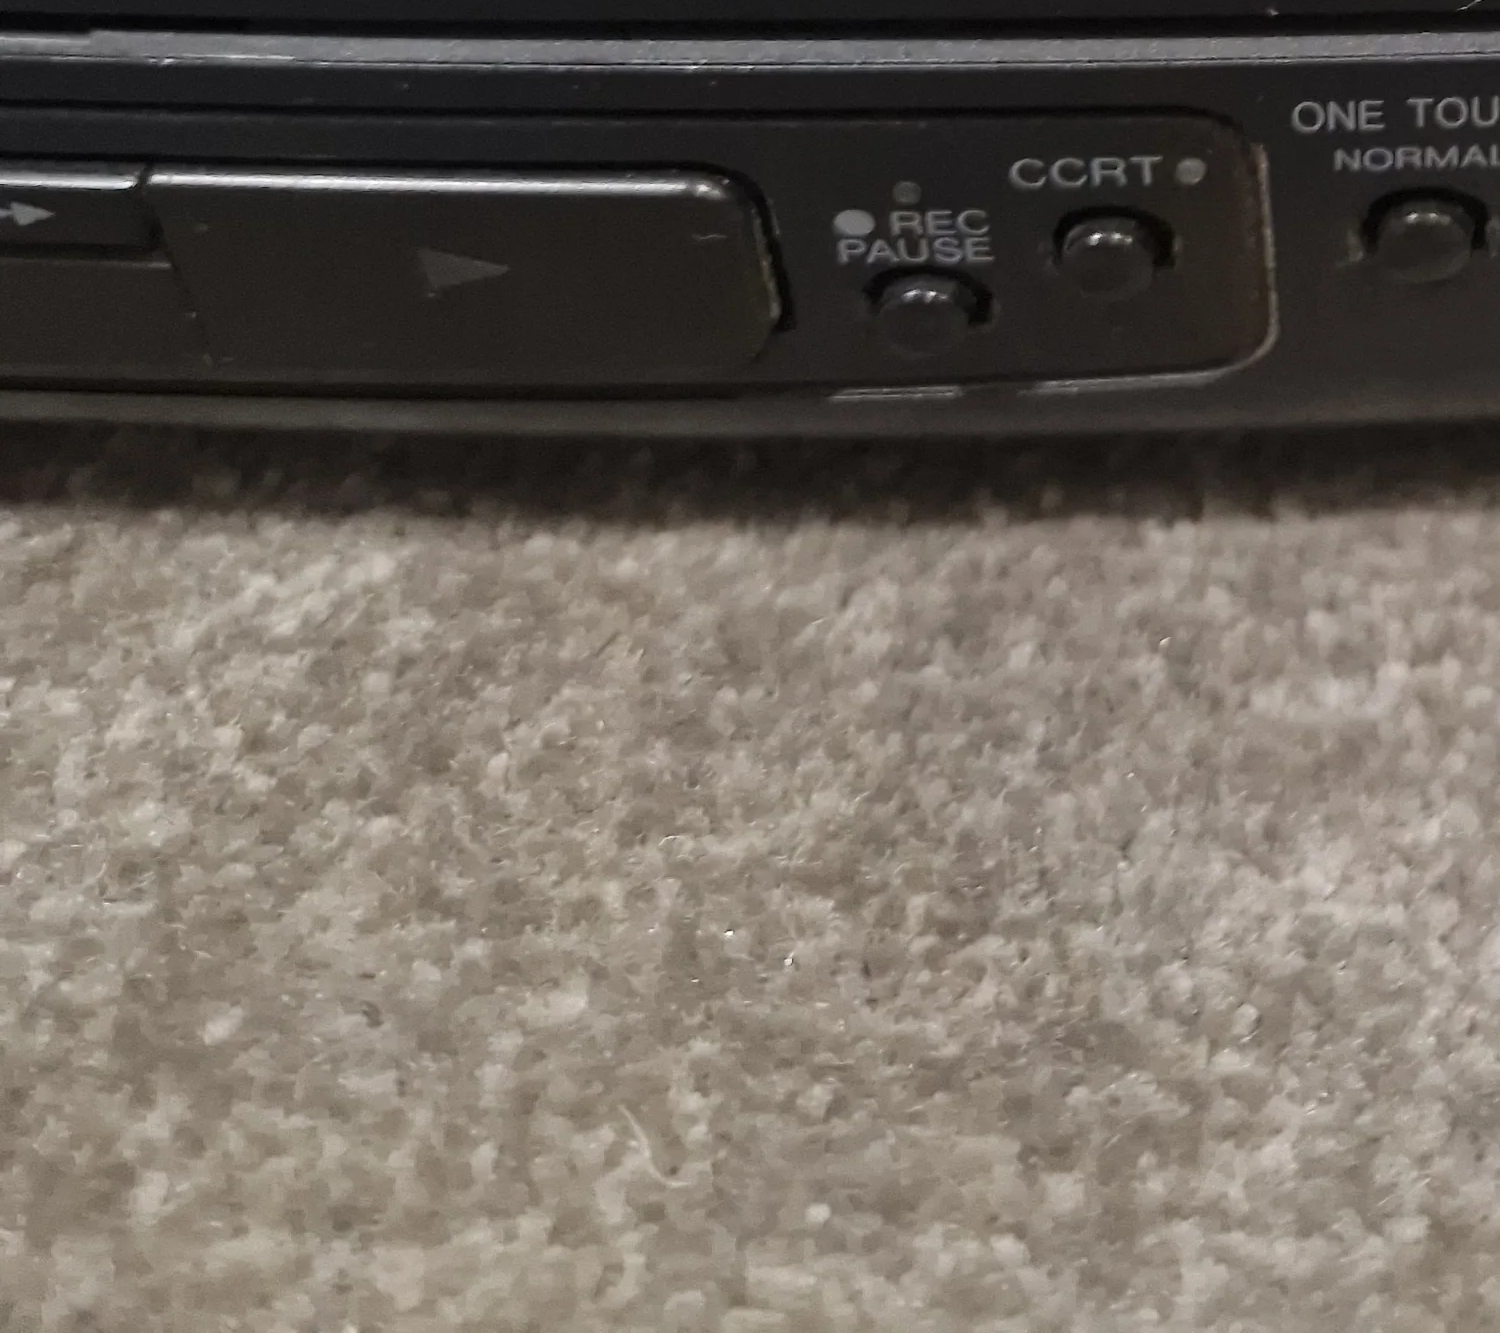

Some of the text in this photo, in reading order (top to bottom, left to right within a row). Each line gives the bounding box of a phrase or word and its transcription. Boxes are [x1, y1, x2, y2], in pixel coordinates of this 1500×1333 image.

[1291, 99, 1386, 133] ONE
[1008, 155, 1163, 189] CCRT
[888, 209, 991, 236] REC
[836, 238, 996, 265] PAUSE
